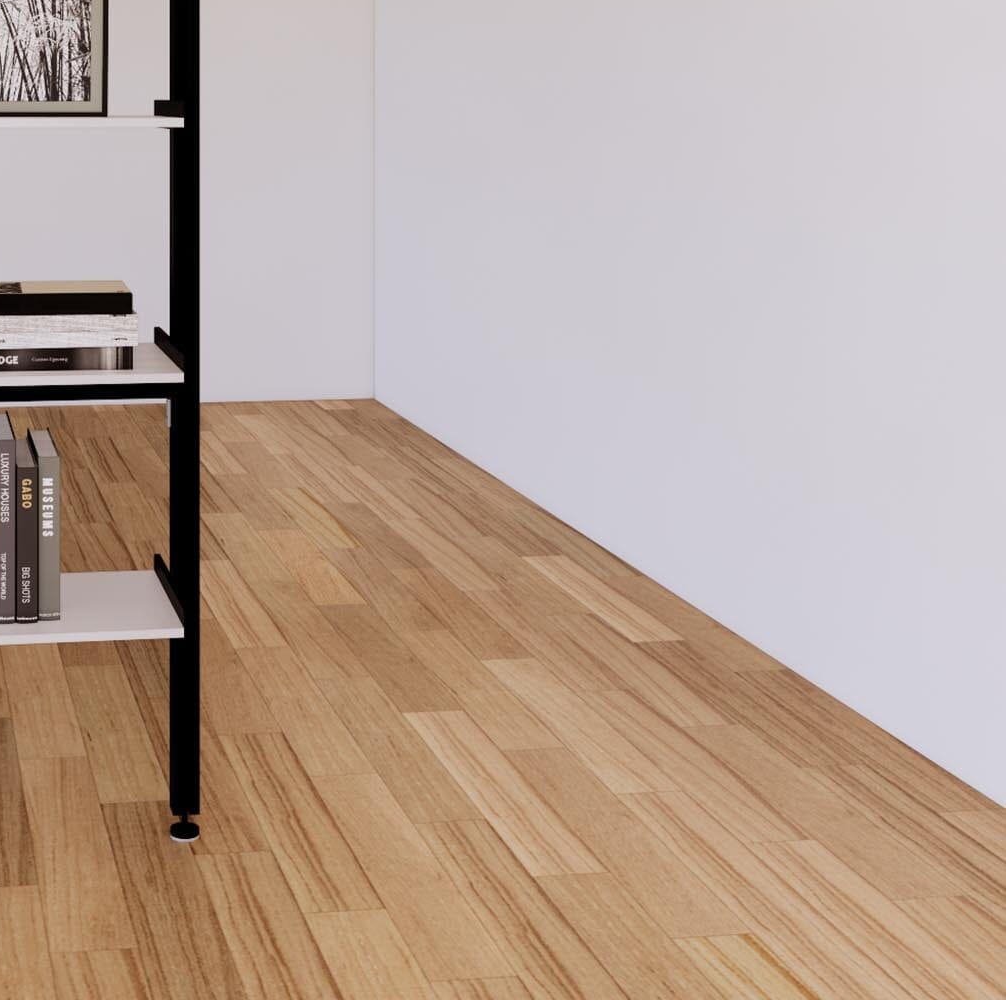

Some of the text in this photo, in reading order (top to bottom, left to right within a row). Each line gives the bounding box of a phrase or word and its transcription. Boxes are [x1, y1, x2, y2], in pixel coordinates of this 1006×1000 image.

[0, 453, 9, 523] LUXURY HOUSES
[22, 478, 32, 509] GABO
[42, 477, 53, 537] MUSEUMS
[21, 567, 30, 603] BIG SHOTS
